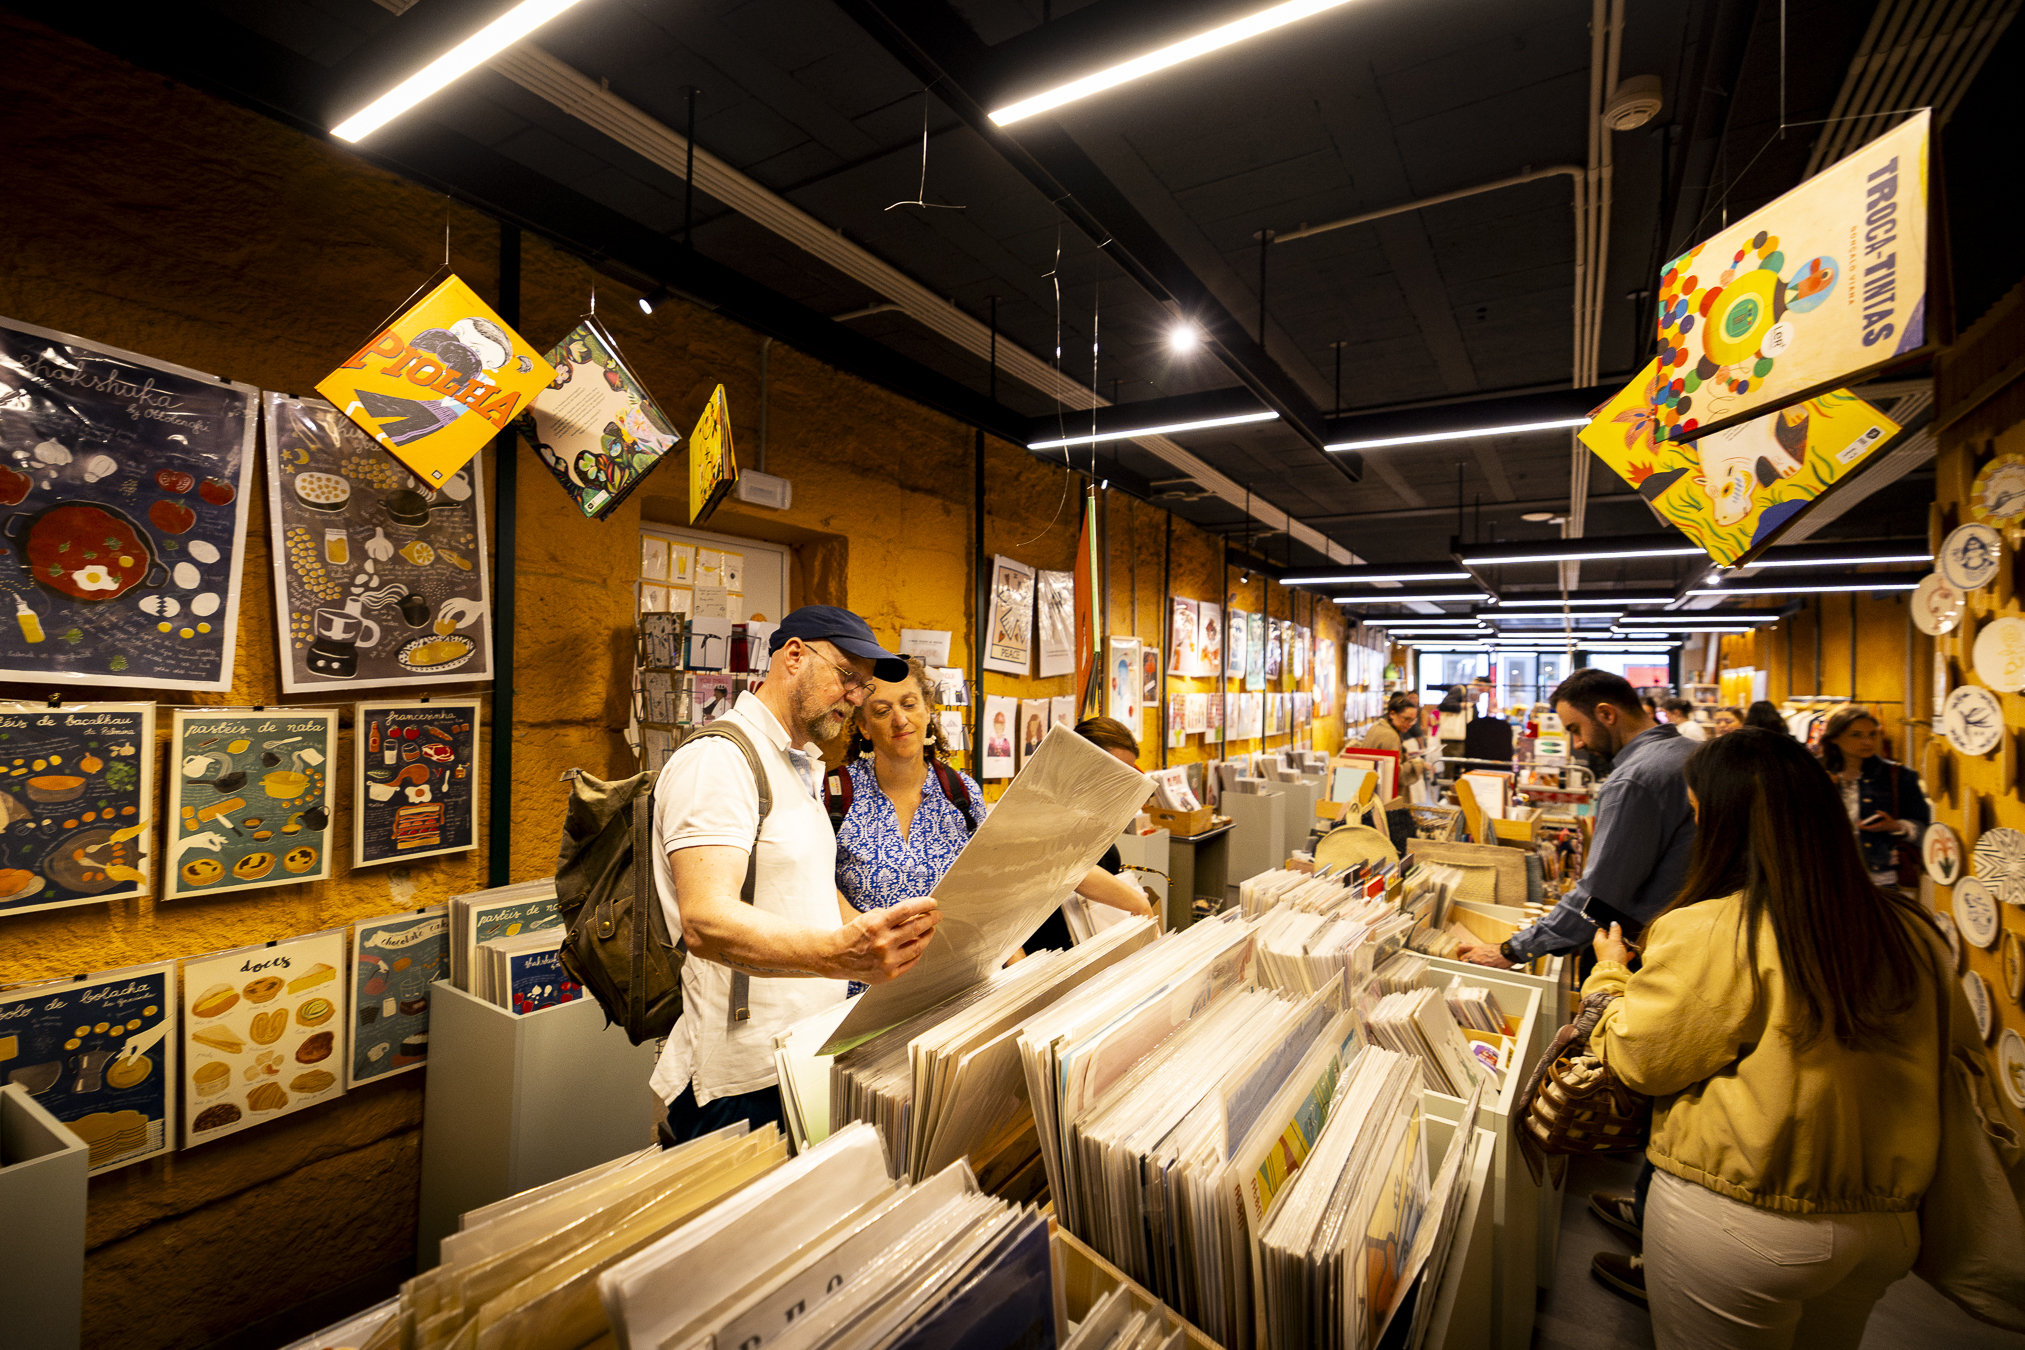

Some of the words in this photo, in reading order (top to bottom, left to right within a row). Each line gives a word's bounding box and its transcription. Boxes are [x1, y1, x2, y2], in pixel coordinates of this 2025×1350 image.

[1862, 155, 1899, 347] TROCA-TINTAS
[1848, 274, 1857, 306] VIANA
[20, 353, 185, 409] shakshuka
[338, 328, 521, 430] PIOLHA
[126, 403, 141, 420] by
[1001, 648, 1020, 660] PEACE
[36, 715, 57, 726] de
[64, 714, 133, 727] bacalhau
[385, 709, 456, 726] francesinha
[184, 721, 250, 737] pastéis
[257, 721, 277, 733] de
[287, 720, 325, 732] nata
[477, 905, 521, 928] pastéis
[526, 904, 540, 916] de
[381, 930, 424, 947] chocolate
[240, 956, 291, 972] doces
[44, 998, 68, 1011] de
[79, 981, 151, 1004] bolacha
